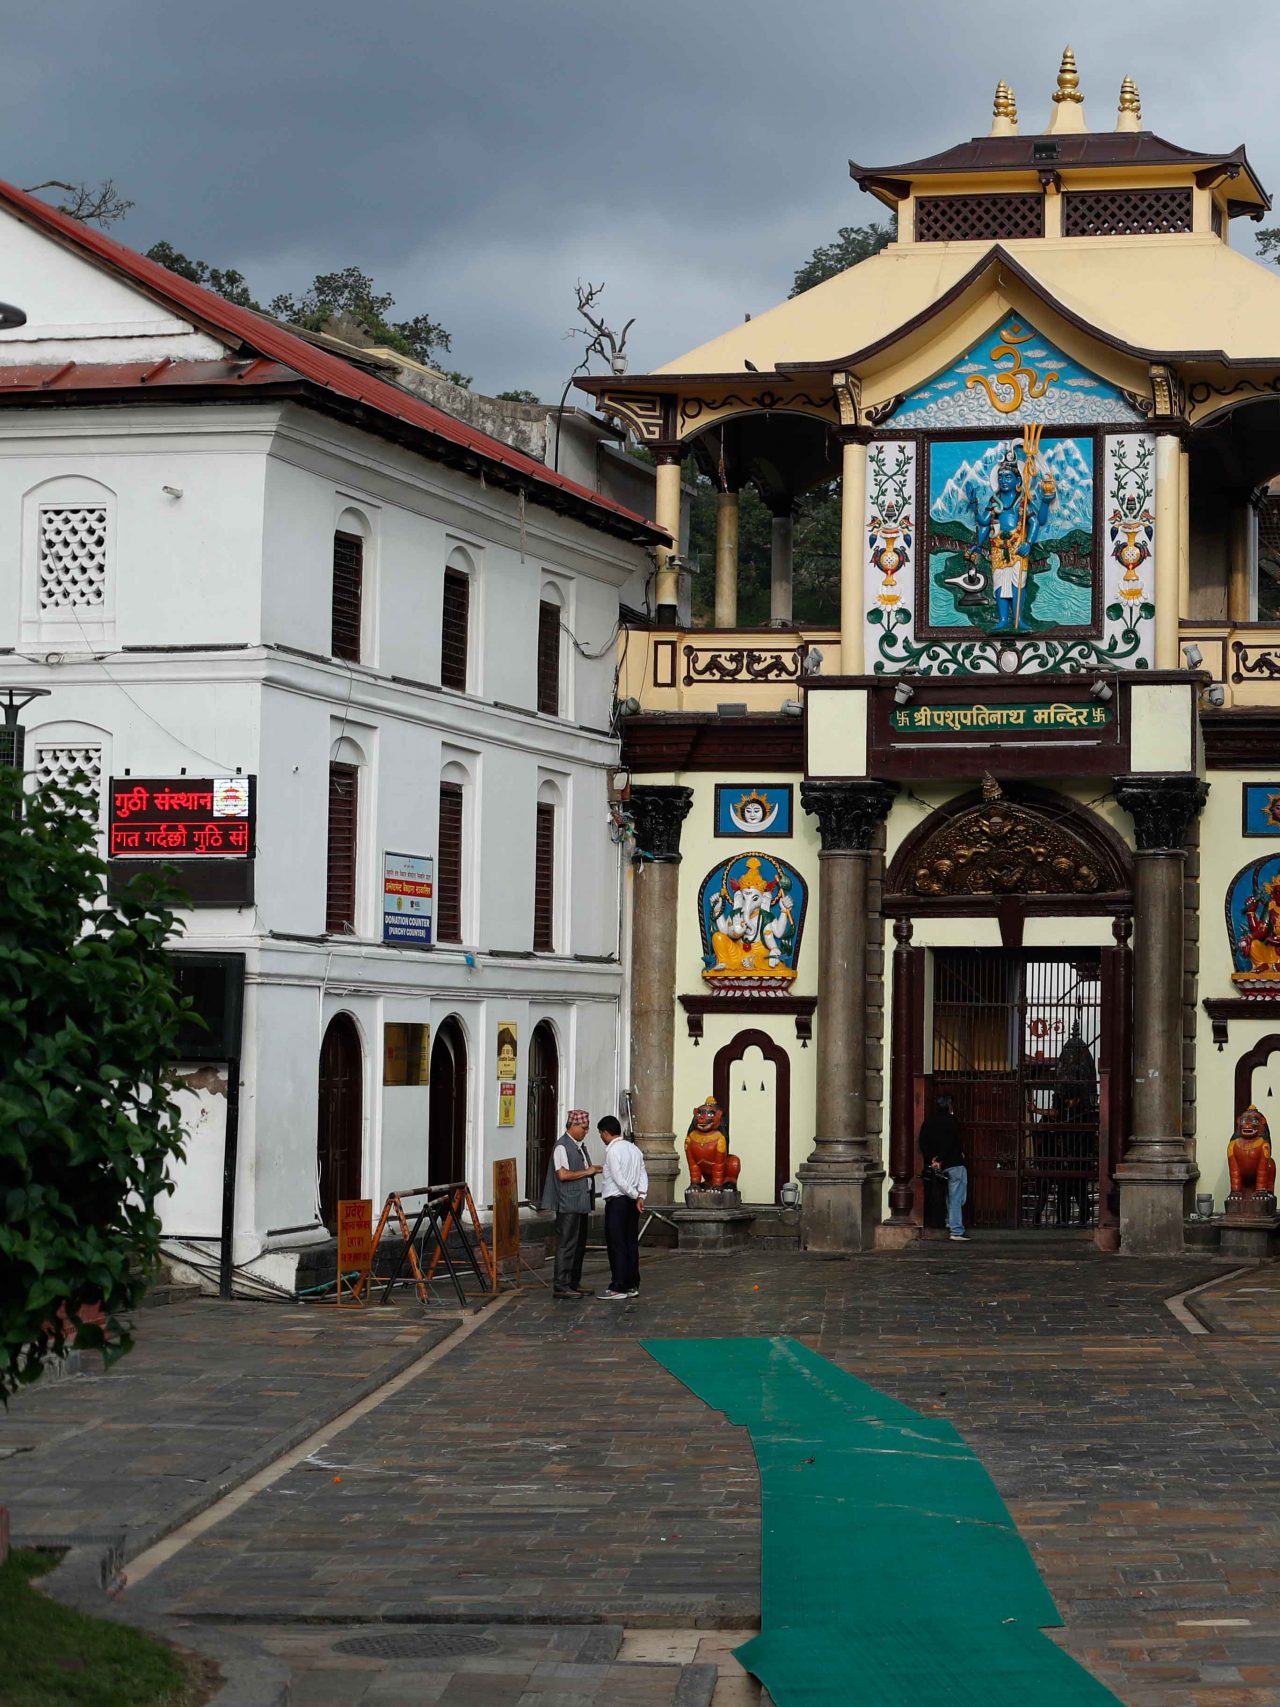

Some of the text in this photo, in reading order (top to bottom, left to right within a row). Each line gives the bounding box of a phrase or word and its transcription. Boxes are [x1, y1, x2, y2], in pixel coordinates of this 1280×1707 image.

[1034, 703, 1089, 726] मन्दिर
[114, 786, 214, 818] गुठी संस्थान
[193, 824, 224, 852] गुठि
[385, 915, 430, 928] DONATION COUNTER
[406, 928, 426, 938] COUNTER)
